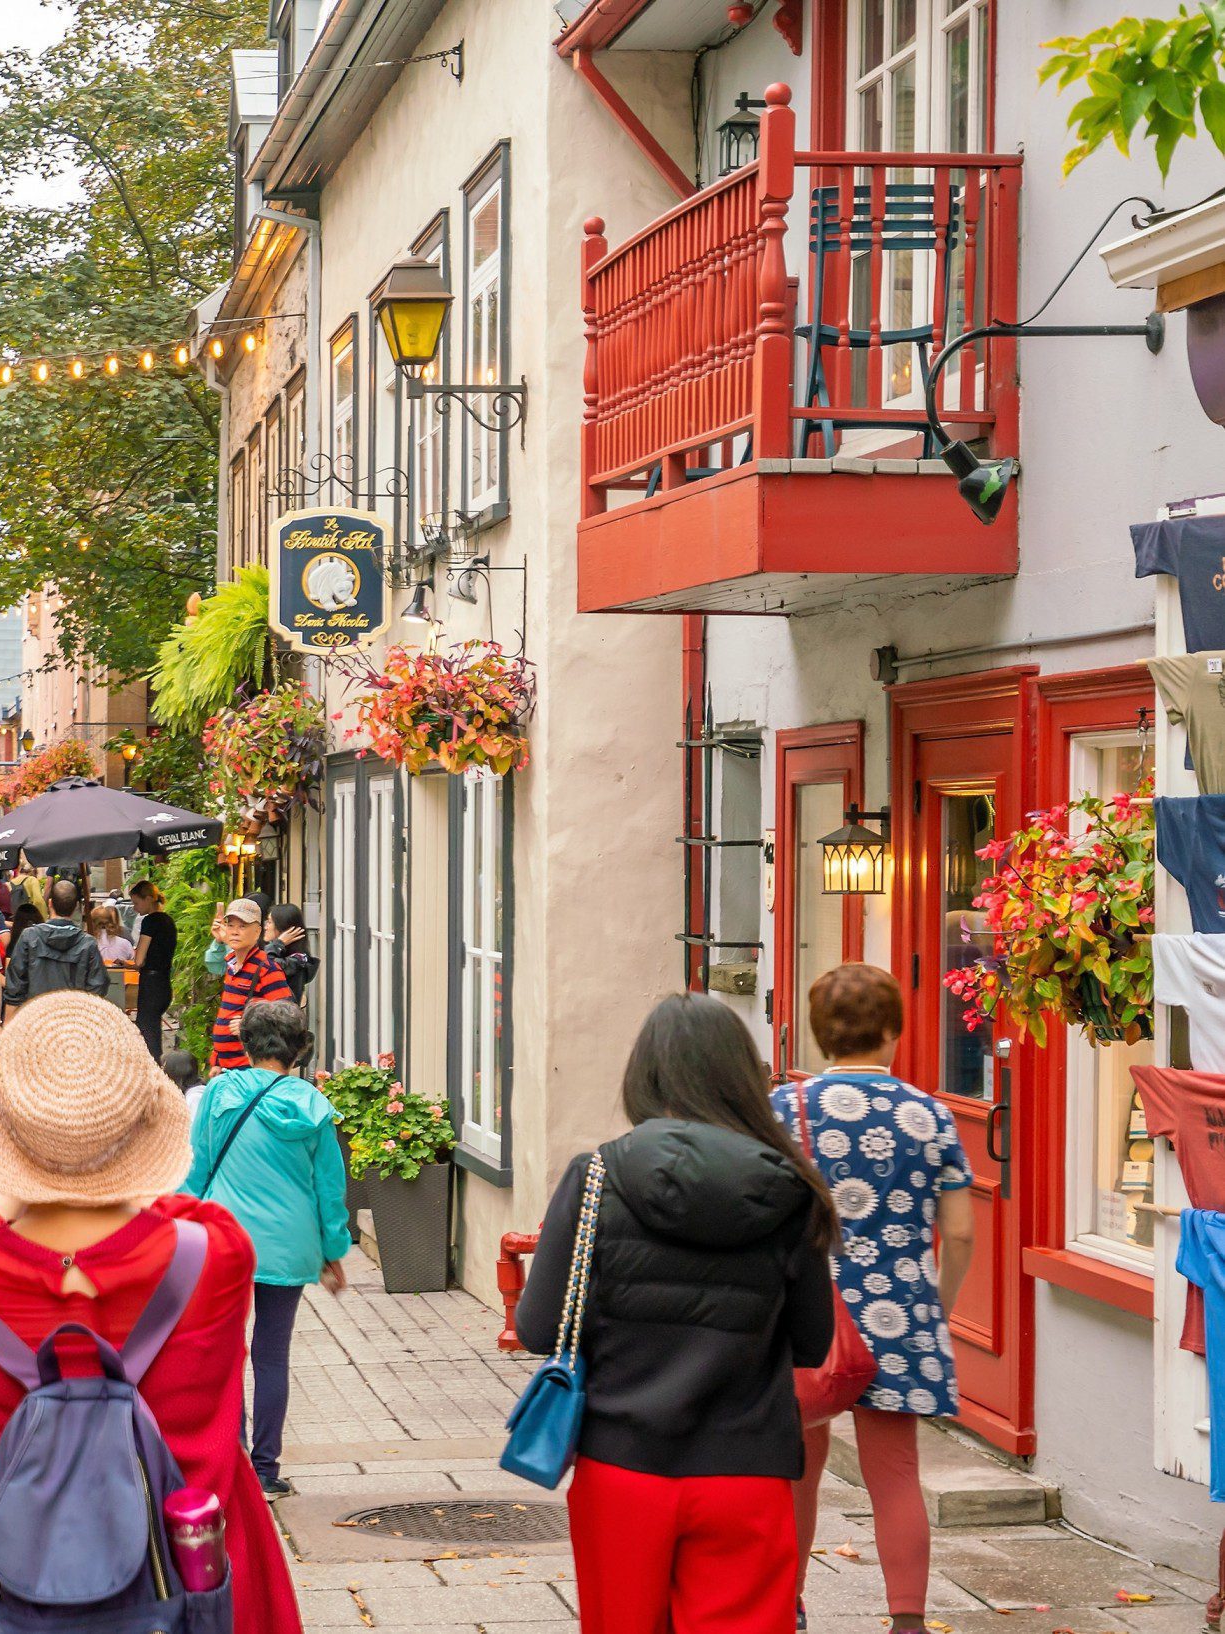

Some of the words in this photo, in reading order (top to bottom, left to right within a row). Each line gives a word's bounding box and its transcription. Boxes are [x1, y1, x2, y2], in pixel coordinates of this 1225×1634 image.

[340, 531, 376, 550] Art
[327, 613, 369, 627] Nicolas
[157, 833, 182, 846] CHEVAL
[181, 829, 208, 842] BLANC
